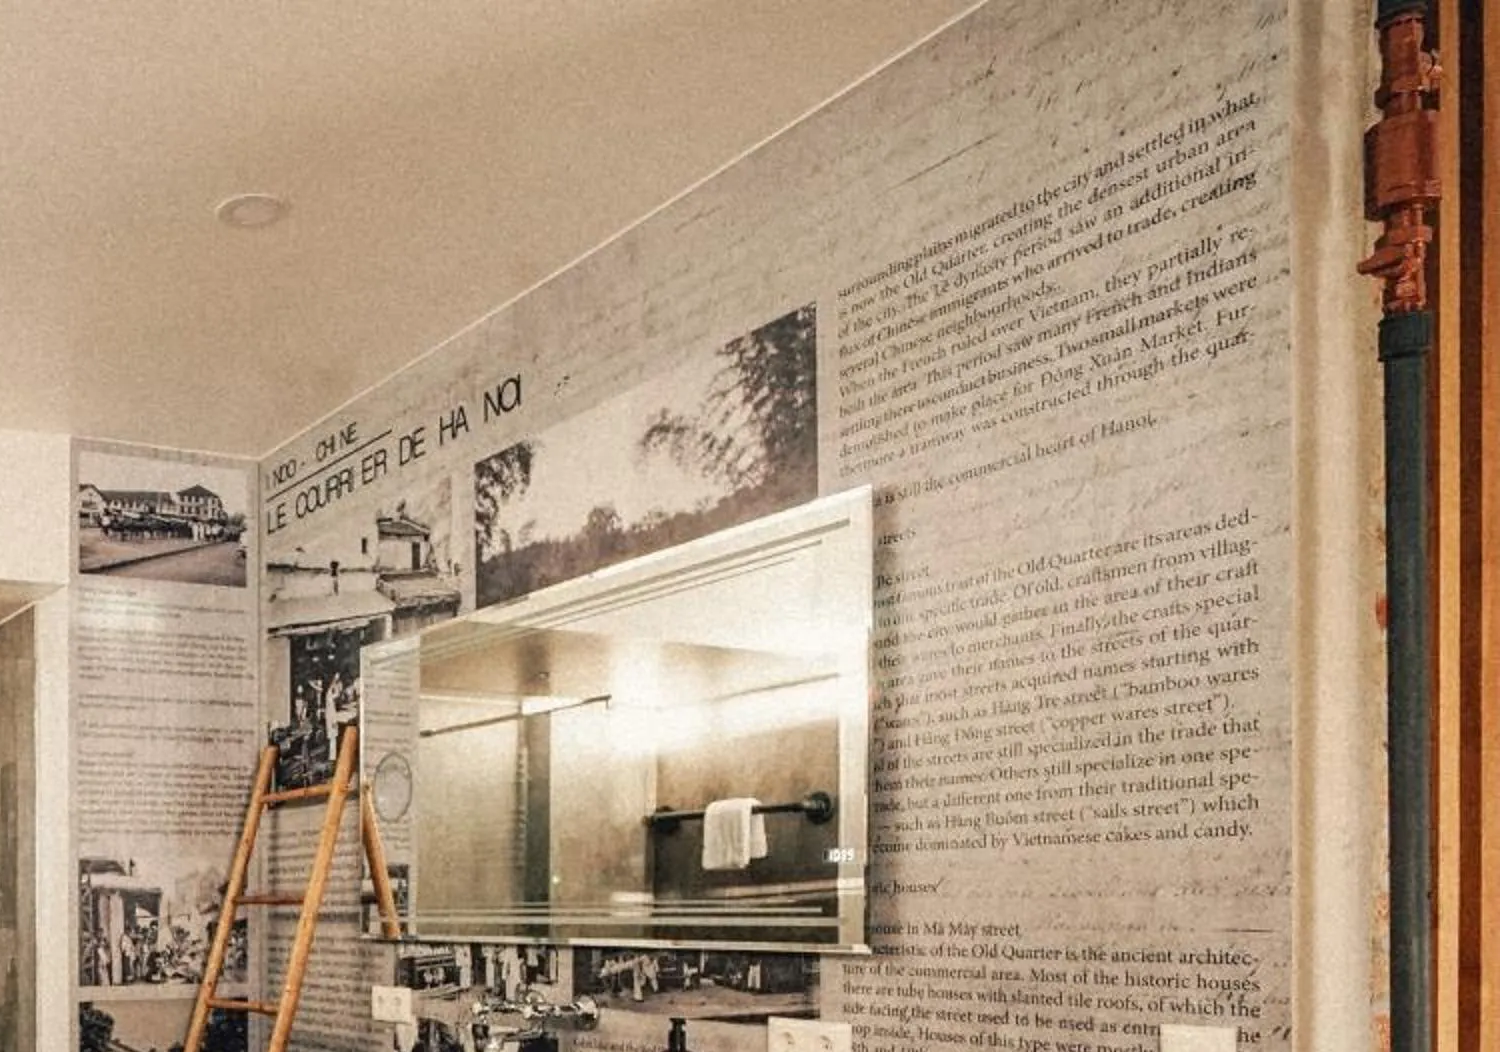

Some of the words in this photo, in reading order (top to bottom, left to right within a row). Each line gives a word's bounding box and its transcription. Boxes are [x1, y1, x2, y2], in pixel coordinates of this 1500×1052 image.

[1057, 197, 1082, 219] the
[1087, 165, 1149, 206] densest
[1155, 139, 1209, 175] urban
[1093, 149, 1125, 179] and
[1129, 154, 1220, 210] additional
[1047, 231, 1102, 269] arrived
[1107, 226, 1122, 244] to
[1180, 169, 1257, 213] creating
[1104, 269, 1138, 293] they
[1147, 235, 1222, 281] partially
[1213, 274, 1257, 302] were
[1036, 316, 1079, 343] many
[1146, 273, 1180, 302] and
[1096, 354, 1164, 392] through
[1171, 345, 1201, 367] the
[267, 502, 287, 535] LE
[399, 426, 426, 466] DE
[439, 406, 469, 445] HA
[484, 374, 521, 423] NOI
[1034, 434, 1075, 459] heart
[1079, 426, 1096, 446] of
[1164, 520, 1211, 543] areas
[1215, 507, 1257, 531] ded-
[1067, 560, 1146, 588] craftsmen
[1152, 549, 1195, 570] from
[1198, 537, 1257, 560] villag-
[1075, 592, 1097, 610] the
[1104, 586, 1136, 604] area
[1143, 578, 1160, 596] of
[1166, 571, 1210, 592] their
[1215, 558, 1258, 582] craft
[1142, 599, 1190, 621] crafts
[1195, 583, 1258, 614] special
[1060, 642, 1084, 659] the
[1149, 626, 1164, 644] of
[1173, 622, 1200, 640] the
[1083, 659, 1136, 678] names
[1140, 647, 1209, 670] starting
[1216, 635, 1259, 658] with
[1206, 666, 1258, 685] wares
[1110, 704, 1158, 722] wares
[1138, 726, 1164, 743] the
[1170, 720, 1217, 740] trade
[1222, 716, 1259, 734] that
[989, 765, 1038, 781] Others
[1043, 759, 1071, 776] still
[1075, 753, 1154, 777] specialize
[1158, 751, 1176, 766] in
[1181, 748, 1214, 763] one
[1219, 744, 1258, 764] spe-
[1078, 780, 1115, 796] their
[1121, 770, 1214, 793] traditional
[1219, 771, 1257, 790] spe-
[1202, 792, 1259, 812] which
[1012, 830, 1101, 846] Vietnamese
[1105, 825, 1151, 842] cakes
[1155, 822, 1187, 839] and
[1193, 819, 1253, 840] candy.
[930, 942, 943, 956] of
[946, 942, 968, 956] the
[971, 943, 997, 957] Old
[1001, 943, 1061, 962] Quarter
[1081, 945, 1106, 961] the
[1111, 948, 1172, 963] ancient
[1178, 948, 1258, 965] architec-
[1031, 967, 1067, 982] Most
[1072, 968, 1089, 983] of
[1093, 969, 1119, 985] the
[1123, 970, 1190, 988] historic
[1196, 972, 1260, 991] houses
[935, 1008, 972, 1022] street
[1015, 1012, 1029, 1026] to
[1035, 1012, 1052, 1028] be
[1058, 1015, 1093, 1031] used
[1099, 1020, 1116, 1032] as
[977, 988, 1006, 1002] with
[1011, 989, 1063, 1006] slanted
[1067, 992, 1092, 1007] tile
[1096, 994, 1143, 1013] roofs,
[1147, 996, 1165, 1012] of
[1170, 997, 1224, 1015] which
[1230, 1000, 1260, 1018] the
[969, 1030, 983, 1045] of
[988, 1032, 1014, 1048] this
